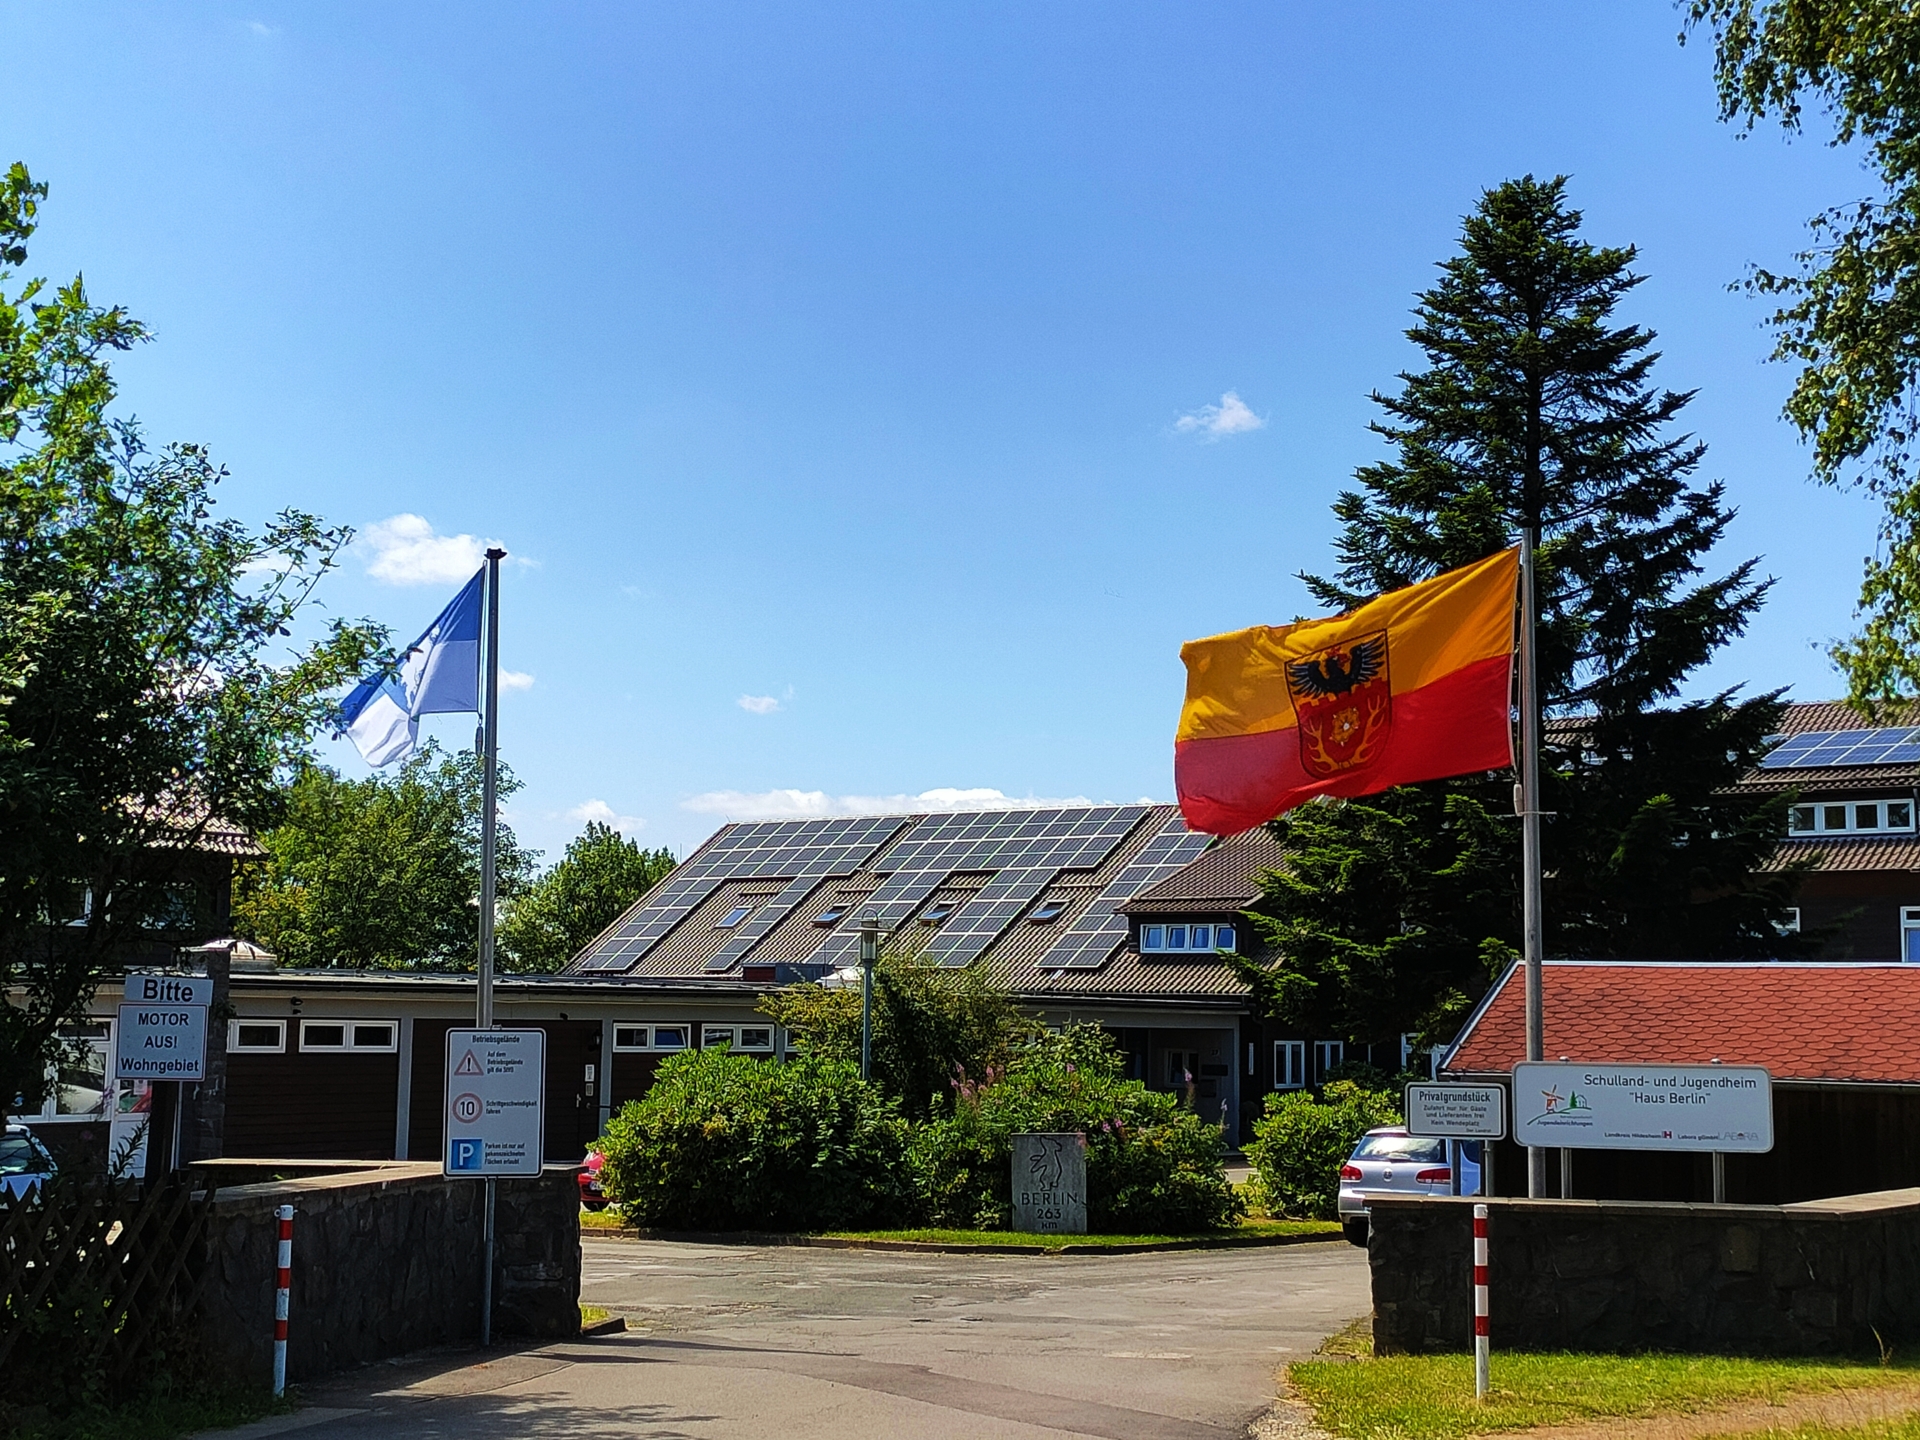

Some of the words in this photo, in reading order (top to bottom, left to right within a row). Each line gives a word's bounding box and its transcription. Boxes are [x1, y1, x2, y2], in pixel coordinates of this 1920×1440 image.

[143, 979, 194, 1002] Bitte
[138, 1013, 189, 1026] MOTOR
[144, 1036, 178, 1049] AUS!
[472, 1034, 521, 1044] Betriebsgelände
[121, 1058, 199, 1074] Wohngebiet
[1584, 1074, 1650, 1087] Schulland-
[1653, 1076, 1677, 1088] und
[1680, 1077, 1757, 1091] Jugendheim
[1419, 1090, 1491, 1104] Privatgrundstück
[1629, 1092, 1665, 1104] "Haus
[1669, 1093, 1711, 1105] Berlin"
[460, 1101, 475, 1116] 10
[459, 1143, 474, 1166] P
[1021, 1192, 1078, 1206] BERLIN
[1037, 1208, 1061, 1219] 263
